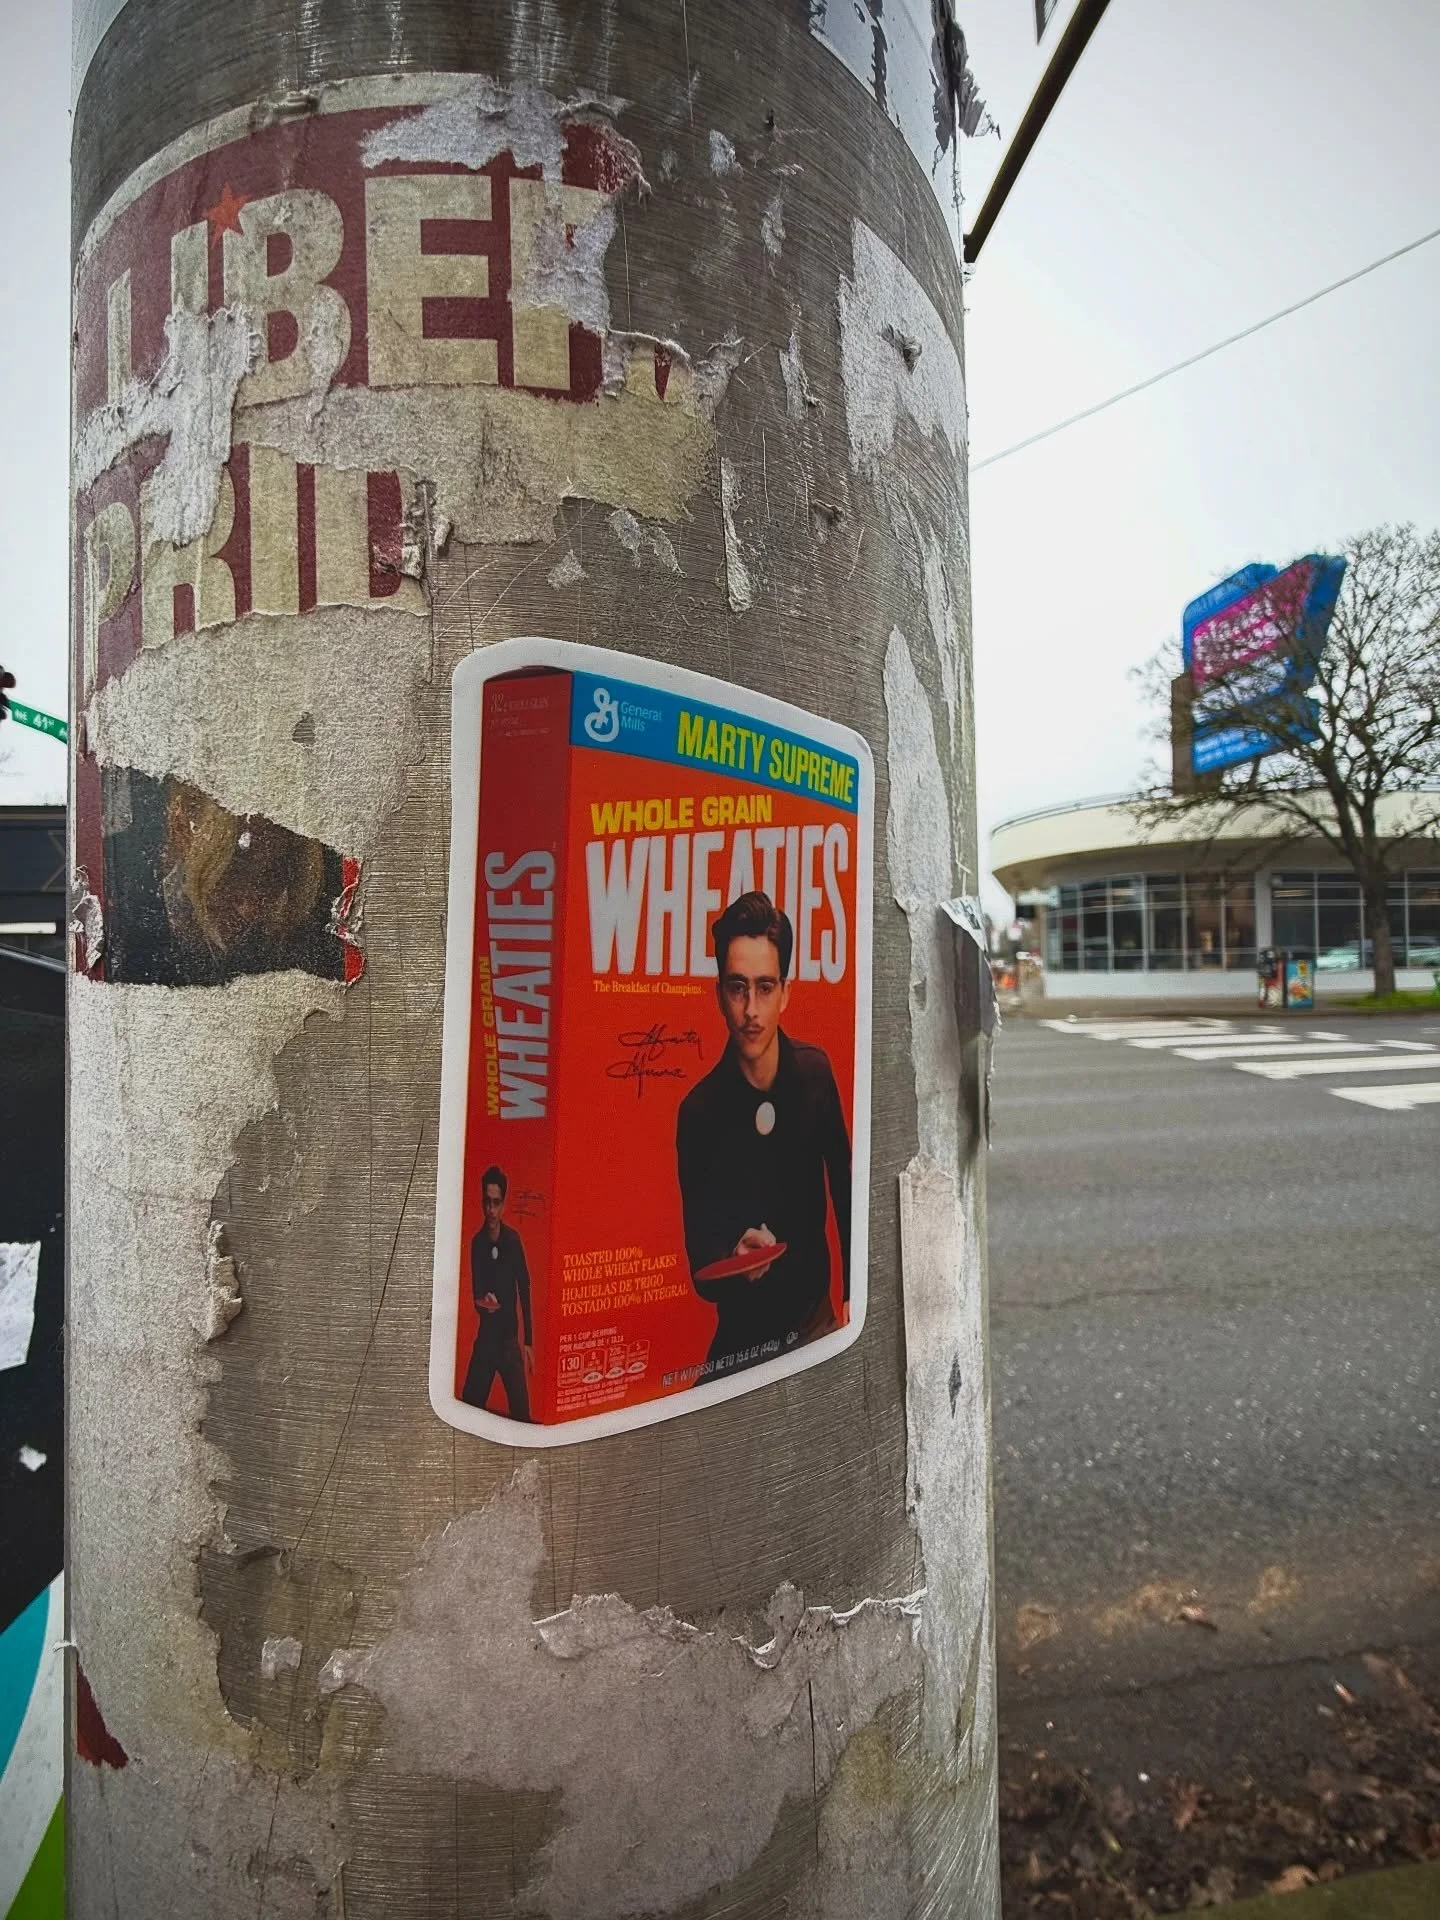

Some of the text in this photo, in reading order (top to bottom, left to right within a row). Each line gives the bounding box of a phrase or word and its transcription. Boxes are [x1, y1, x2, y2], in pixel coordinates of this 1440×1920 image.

[620, 701, 663, 722] General
[620, 716, 645, 732] Mills
[677, 711, 856, 804] MARTY SUPREME
[591, 794, 772, 835] WHOLE GRAIN
[485, 850, 555, 1120] WHEATIES
[594, 980, 610, 993] The
[612, 981, 650, 993] Breakfast
[651, 982, 660, 993] of
[478, 956, 500, 1117] WHOLE GRAIN
[562, 1253, 677, 1283] WHOLE WHEAT FLAKES
[563, 1246, 643, 1268] TOASTED 100%
[561, 1283, 688, 1317] TOSTADO 100% INTEGRAL
[562, 1273, 664, 1302] HOJUELAS DE TRIGO
[559, 1333, 572, 1343] PER
[578, 1331, 591, 1340] CUP
[562, 1356, 580, 1371] 130
[663, 1371, 679, 1388] NET
